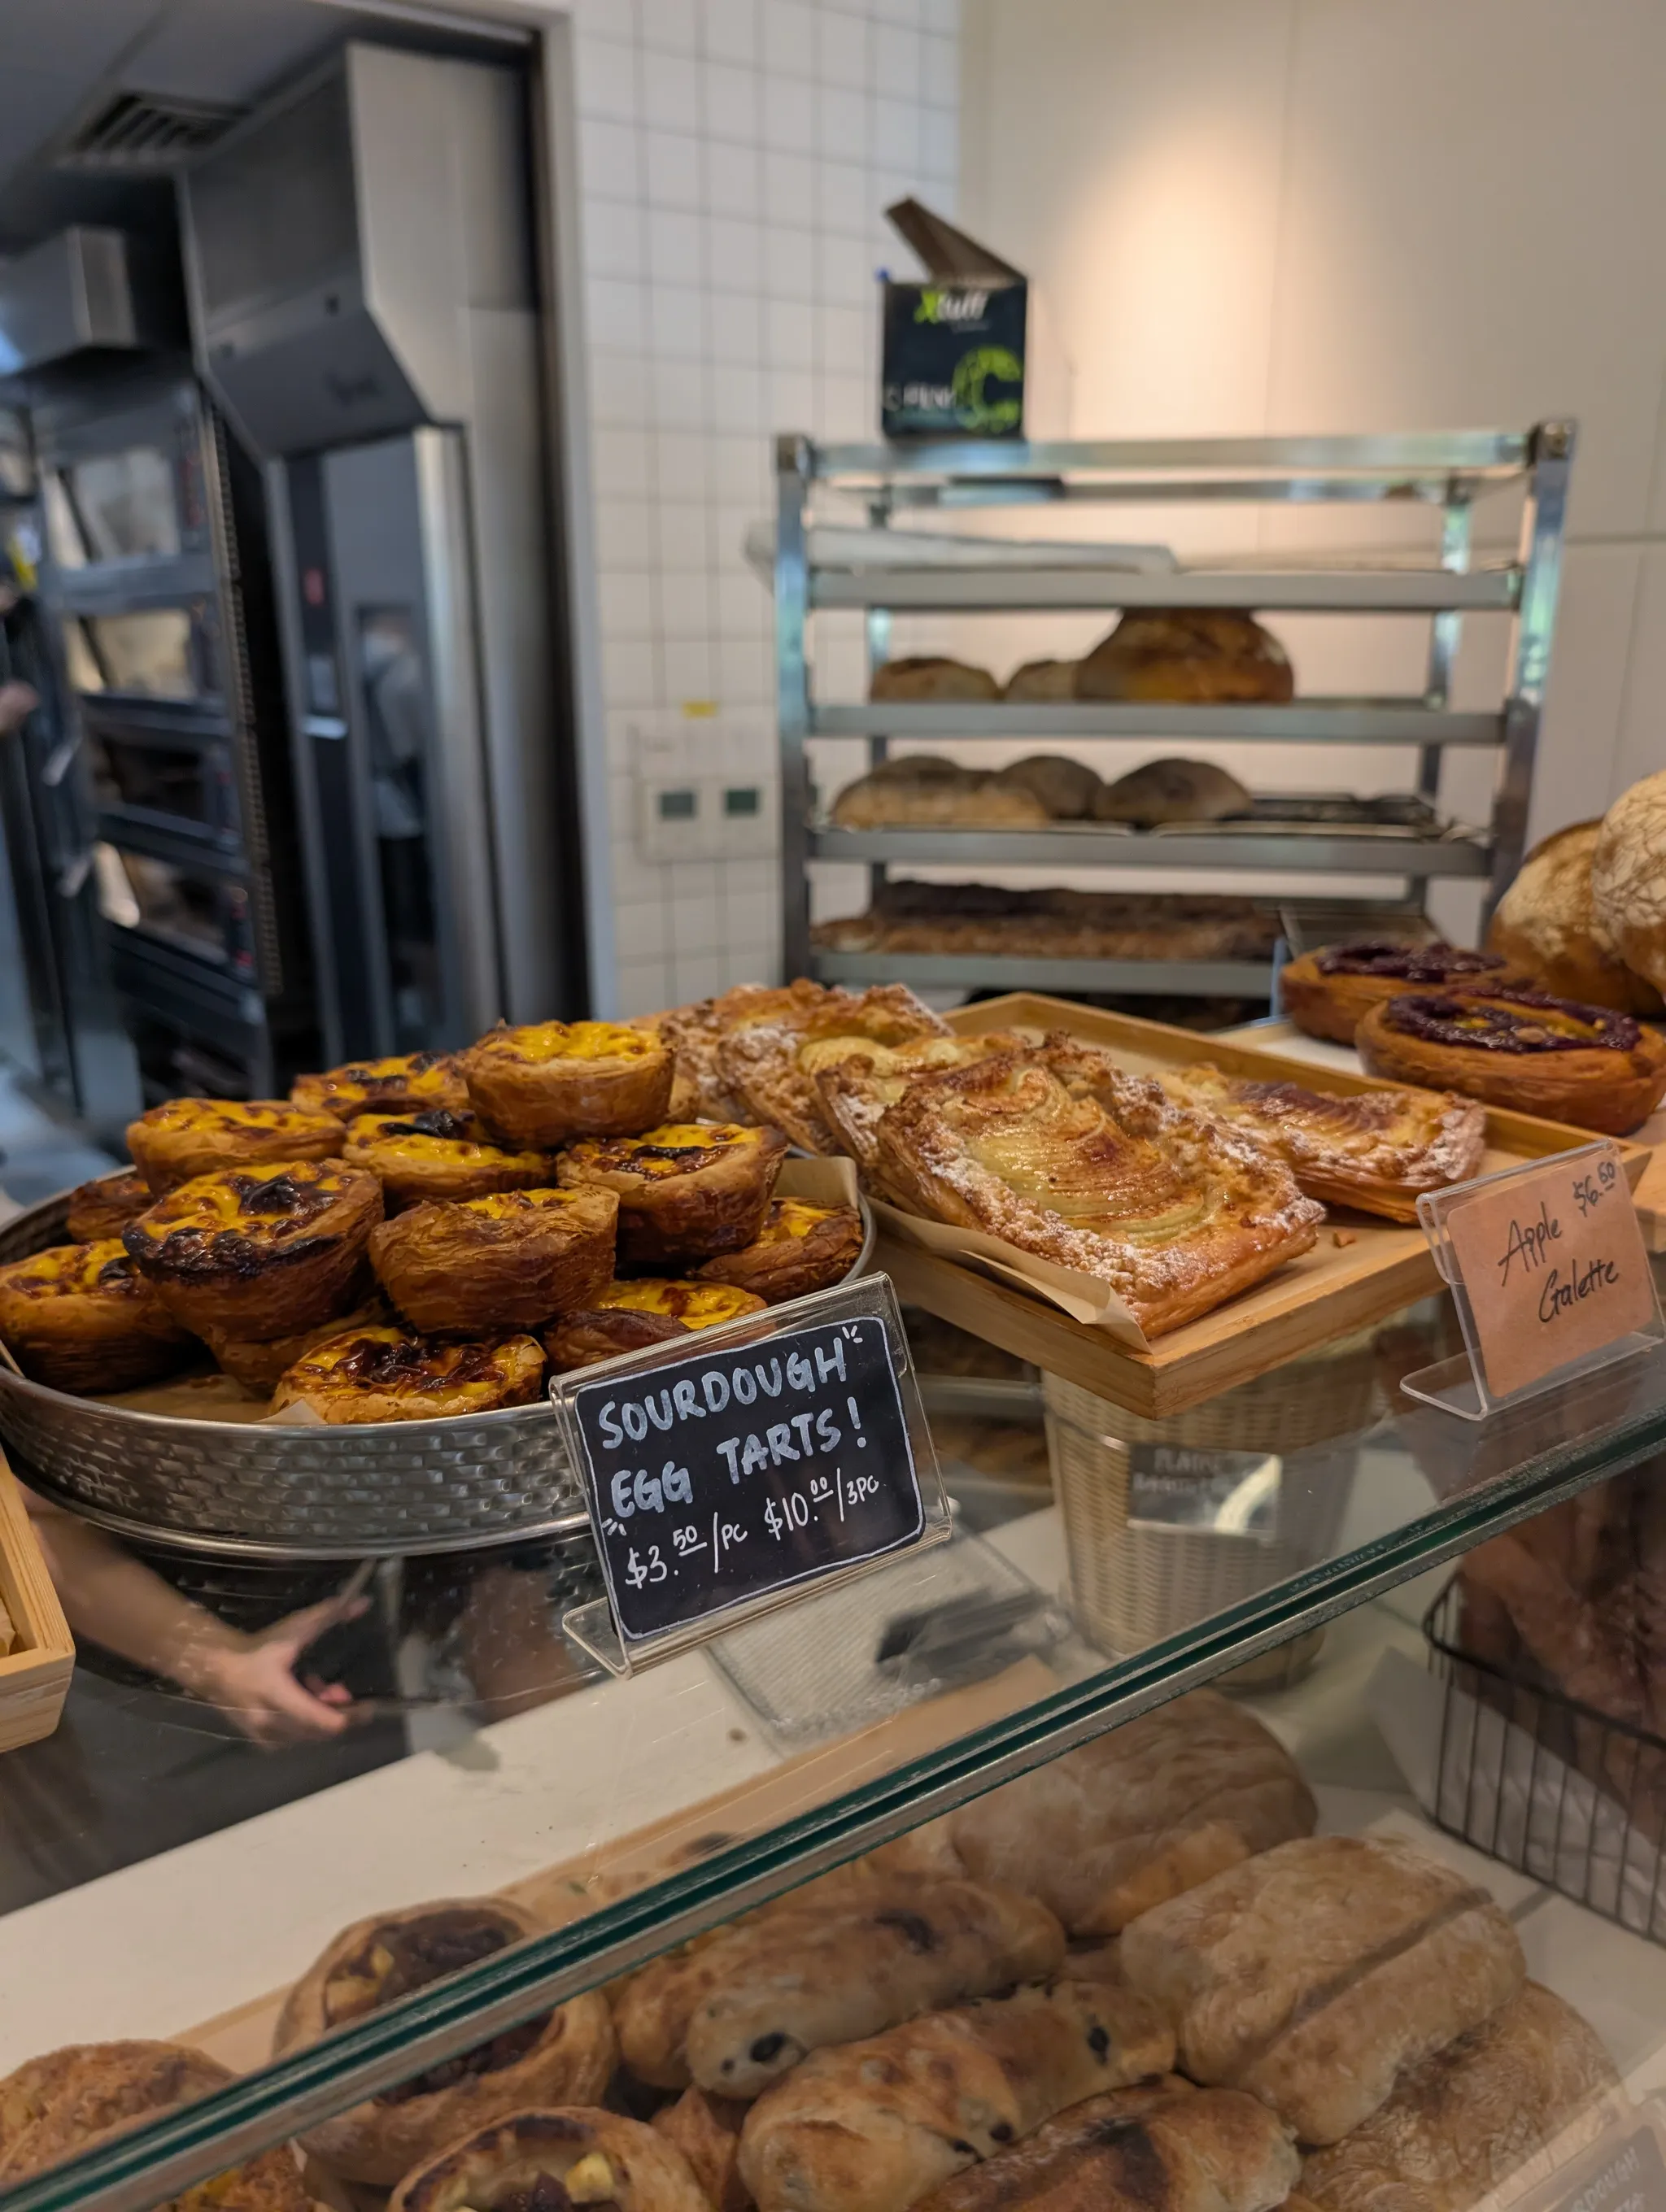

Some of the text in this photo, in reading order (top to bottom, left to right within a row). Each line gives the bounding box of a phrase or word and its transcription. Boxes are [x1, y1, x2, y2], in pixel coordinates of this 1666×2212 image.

[1498, 1201, 1563, 1287] Apple
[1538, 1259, 1620, 1324] Galette
[599, 1338, 847, 1449] SOURDOUGH
[611, 1396, 867, 1517] EGG TARTS!
